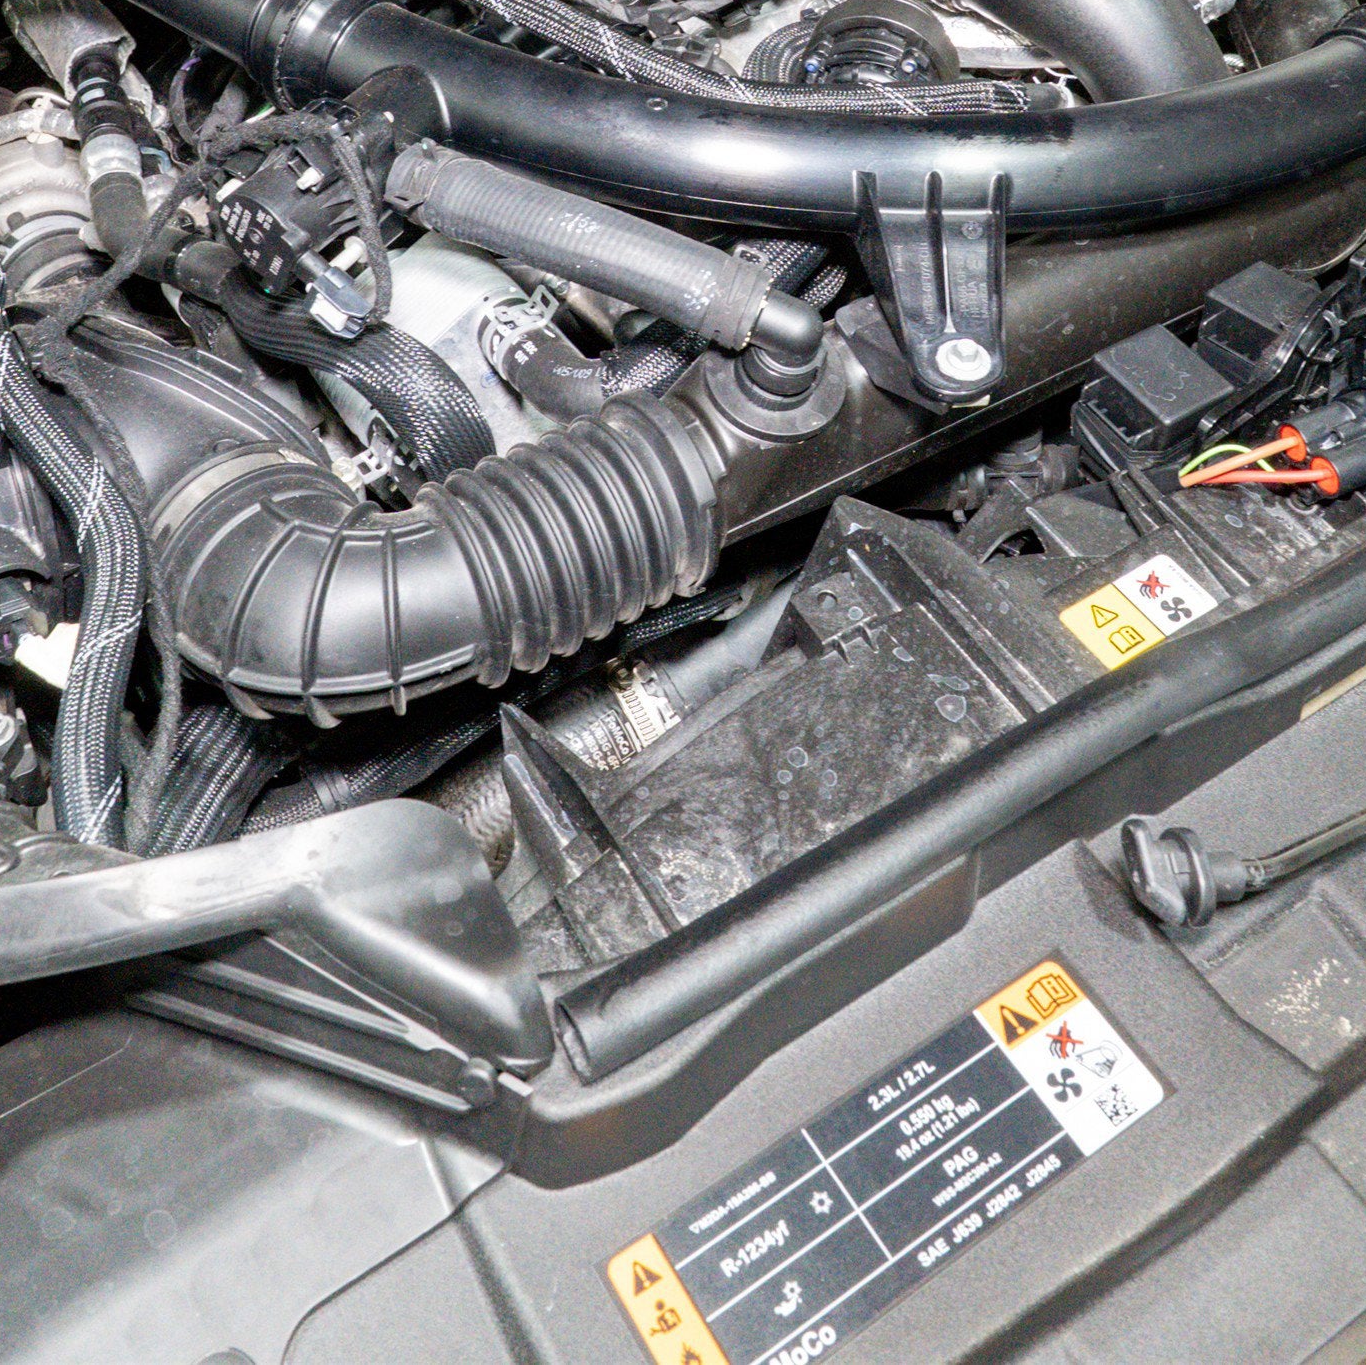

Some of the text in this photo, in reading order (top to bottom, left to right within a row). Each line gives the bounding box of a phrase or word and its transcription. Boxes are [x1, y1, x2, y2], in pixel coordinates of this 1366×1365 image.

[514, 350, 529, 365] OUT
[604, 714, 629, 755] FoMoCo
[867, 1080, 900, 1112] 2.3L
[903, 1057, 936, 1087] 2.7L
[898, 1091, 955, 1138] 0.550 kg
[894, 1136, 923, 1162] 19.4
[918, 1130, 936, 1147] oz
[942, 1145, 980, 1178] PAG
[916, 1153, 1062, 1269] SAE J639 J2842 J2845
[719, 1220, 793, 1278] R-1234yf
